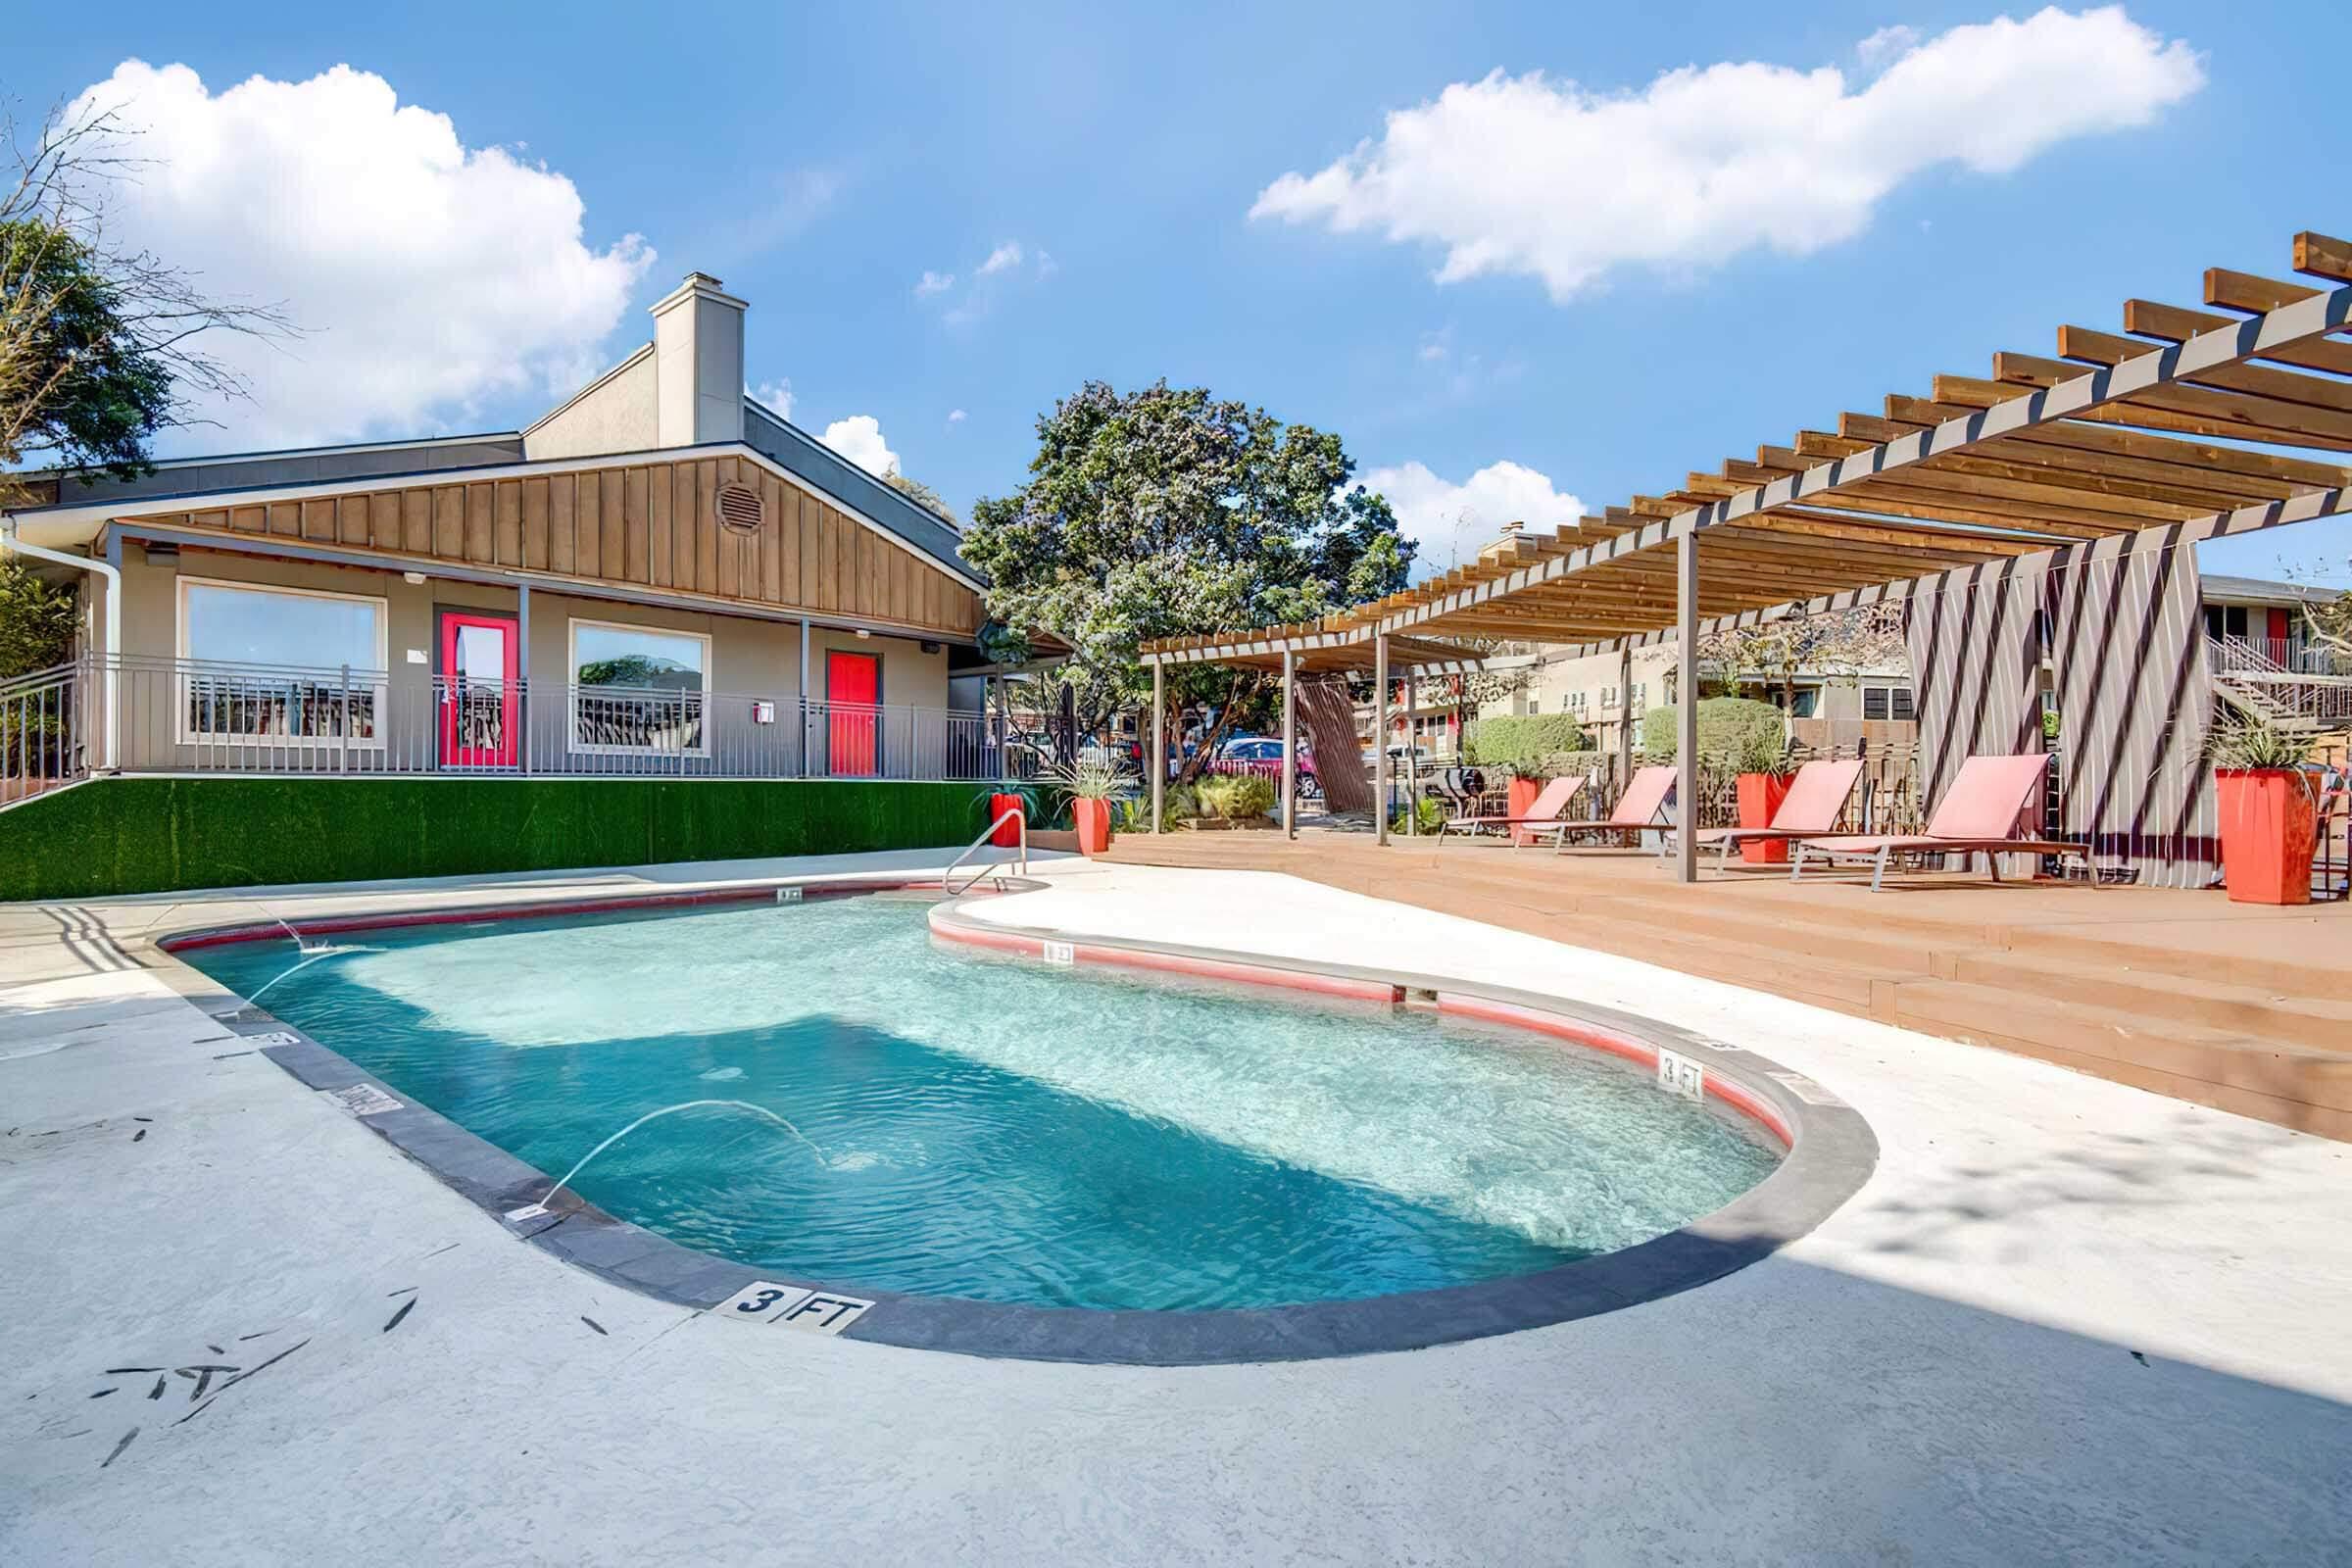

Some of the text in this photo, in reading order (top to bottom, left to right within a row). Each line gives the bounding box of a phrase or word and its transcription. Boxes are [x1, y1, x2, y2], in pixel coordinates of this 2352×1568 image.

[1663, 1057, 1673, 1083] 3
[737, 1289, 863, 1327] 3 FT
